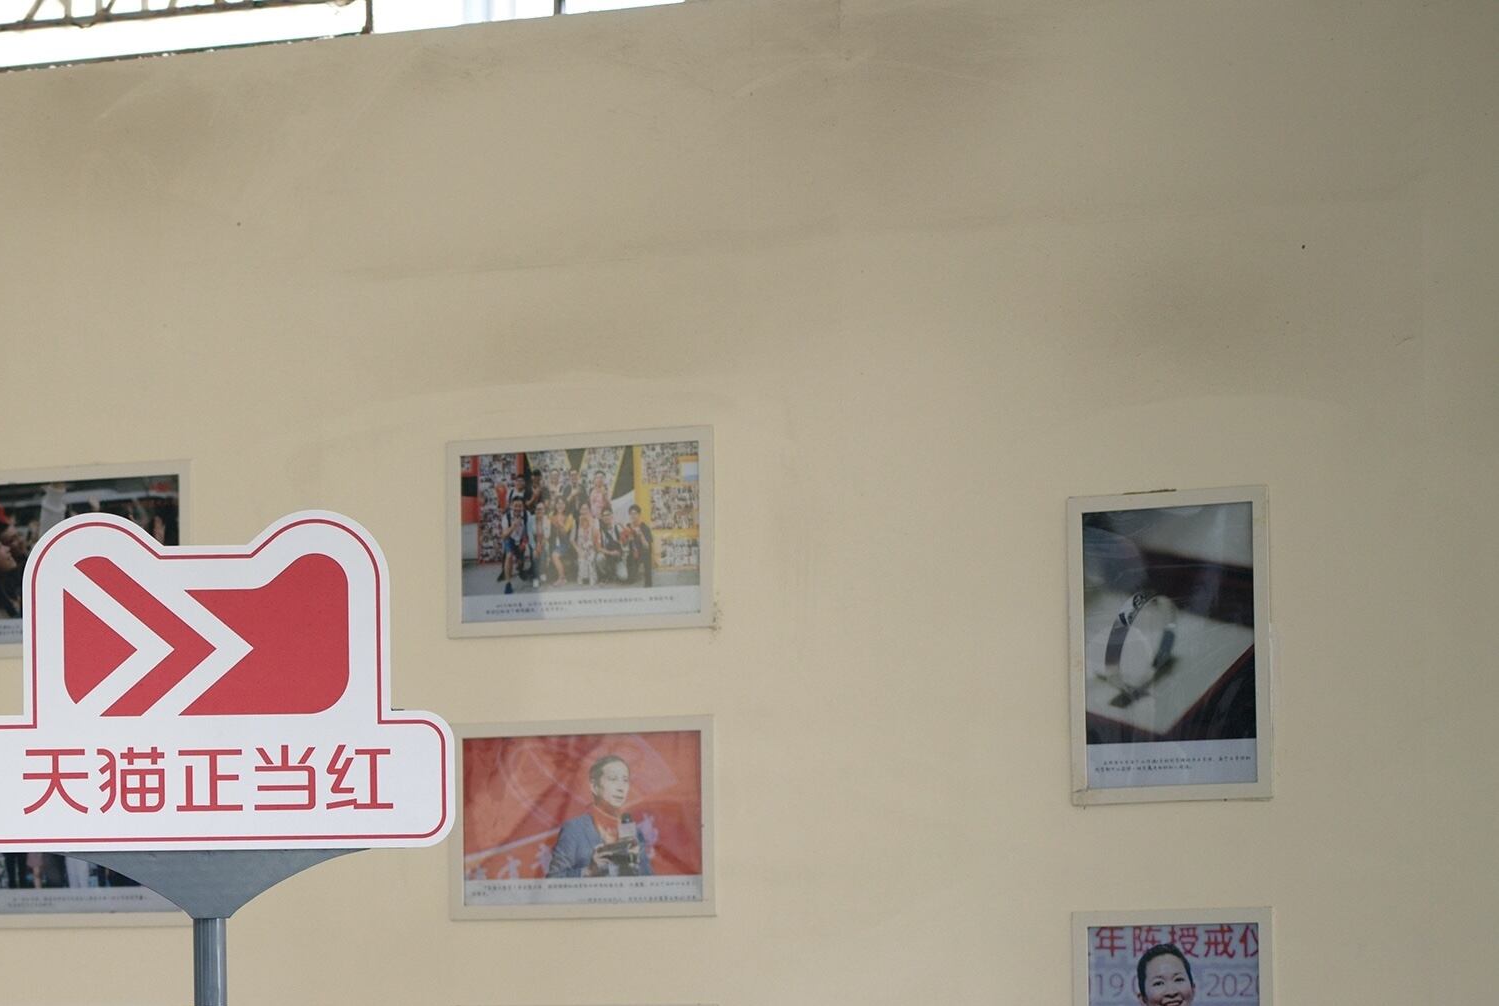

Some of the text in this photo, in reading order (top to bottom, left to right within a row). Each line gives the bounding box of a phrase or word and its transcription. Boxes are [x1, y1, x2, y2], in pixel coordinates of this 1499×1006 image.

[23, 744, 394, 815] 天猫正当红
